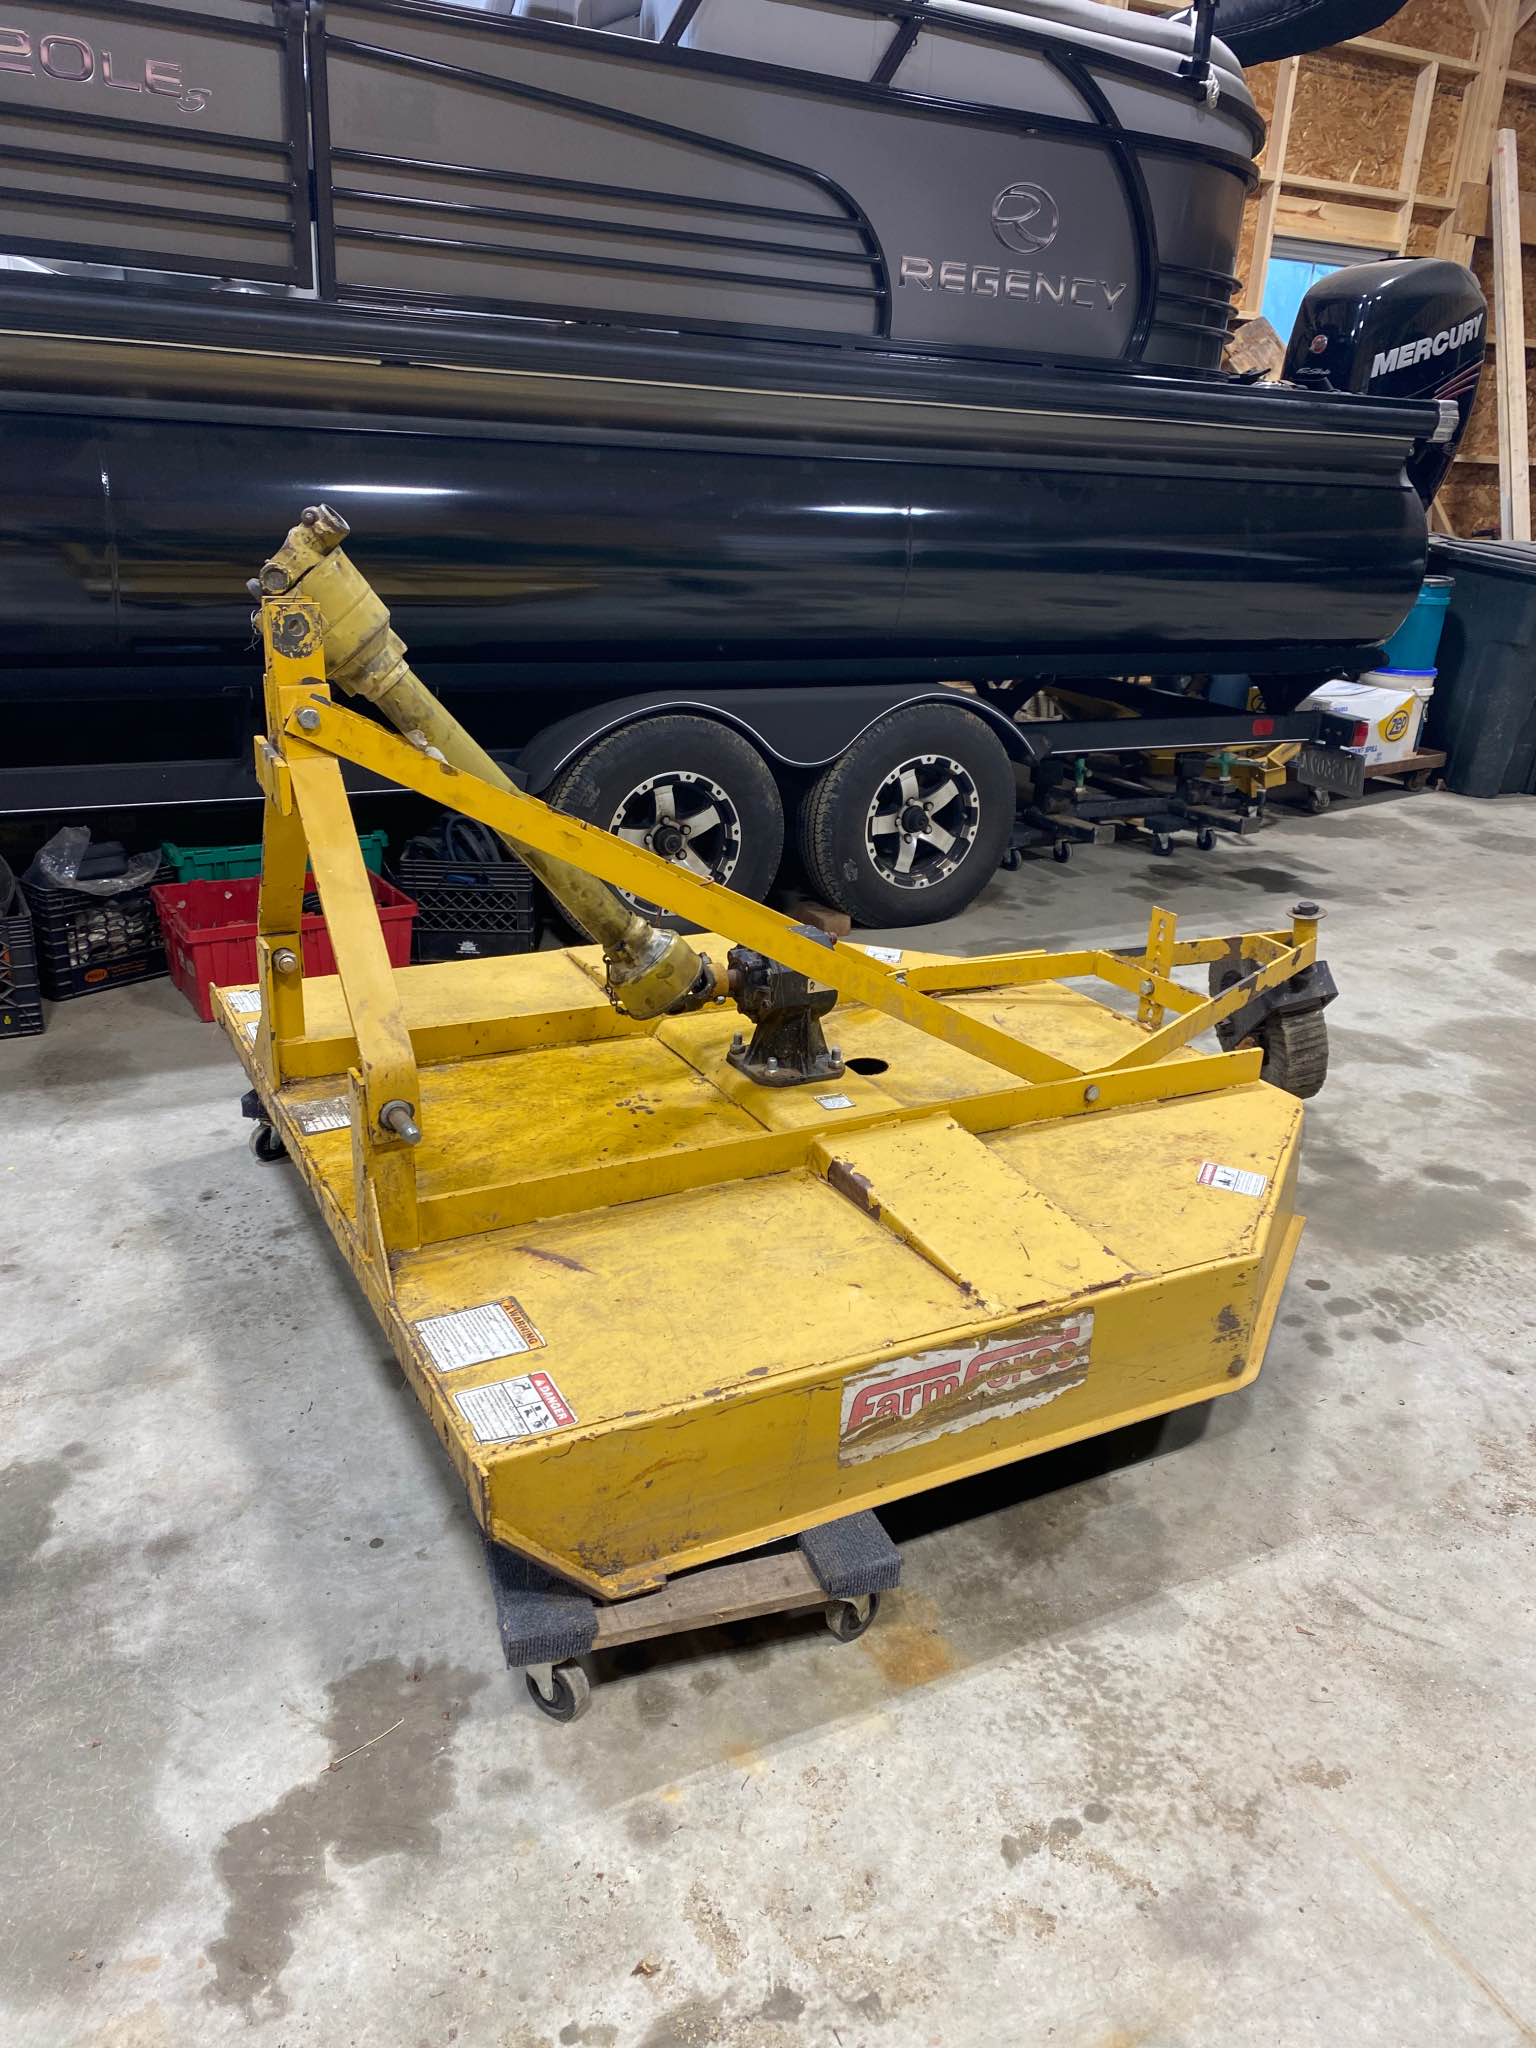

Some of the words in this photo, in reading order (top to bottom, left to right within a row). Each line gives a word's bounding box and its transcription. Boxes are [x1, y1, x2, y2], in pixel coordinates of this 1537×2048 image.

[898, 255, 1128, 312] REGENCY
[1370, 313, 1483, 379] MERCURY
[507, 1308, 538, 1345] WARNING
[540, 1385, 569, 1421] DANGER
[847, 1360, 962, 1433] Farm
